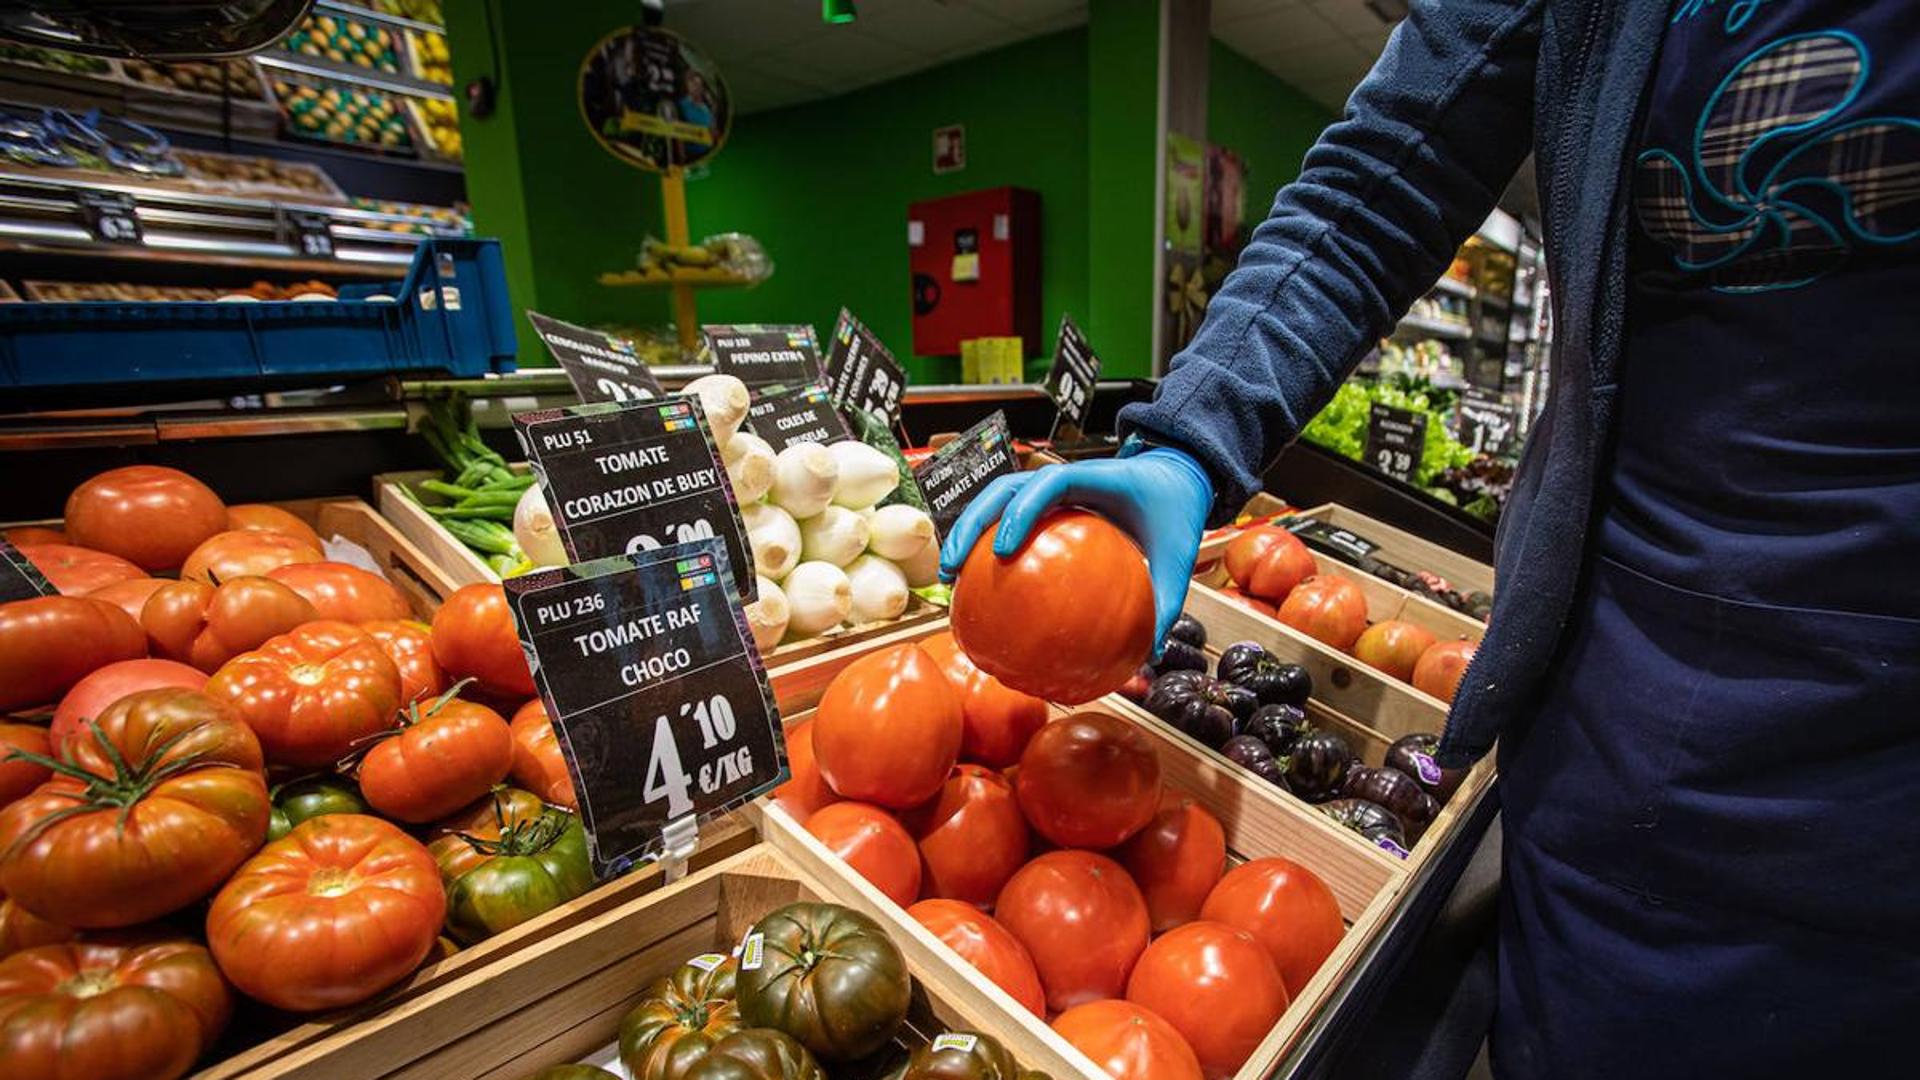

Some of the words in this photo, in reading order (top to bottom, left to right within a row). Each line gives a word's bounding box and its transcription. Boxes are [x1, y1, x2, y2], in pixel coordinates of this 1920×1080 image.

[730, 351, 770, 364] PEPINO
[771, 350, 805, 362] EXTRA
[776, 413, 803, 430] COLES
[803, 410, 818, 424] DE
[544, 433, 572, 450] PLU
[575, 429, 593, 445] 51
[594, 446, 670, 475] TOMATE
[564, 484, 651, 519] CORAZON
[652, 478, 676, 497] DE
[676, 468, 716, 492] BUEY
[932, 475, 972, 511] TOMATE
[970, 450, 1007, 482] VIOLETA
[537, 604, 571, 625] PLU
[573, 593, 605, 616] 236
[574, 614, 665, 657] TOMATE
[667, 603, 702, 631] RAF
[620, 648, 691, 687] CHOCO
[699, 745, 753, 795] €/KG
